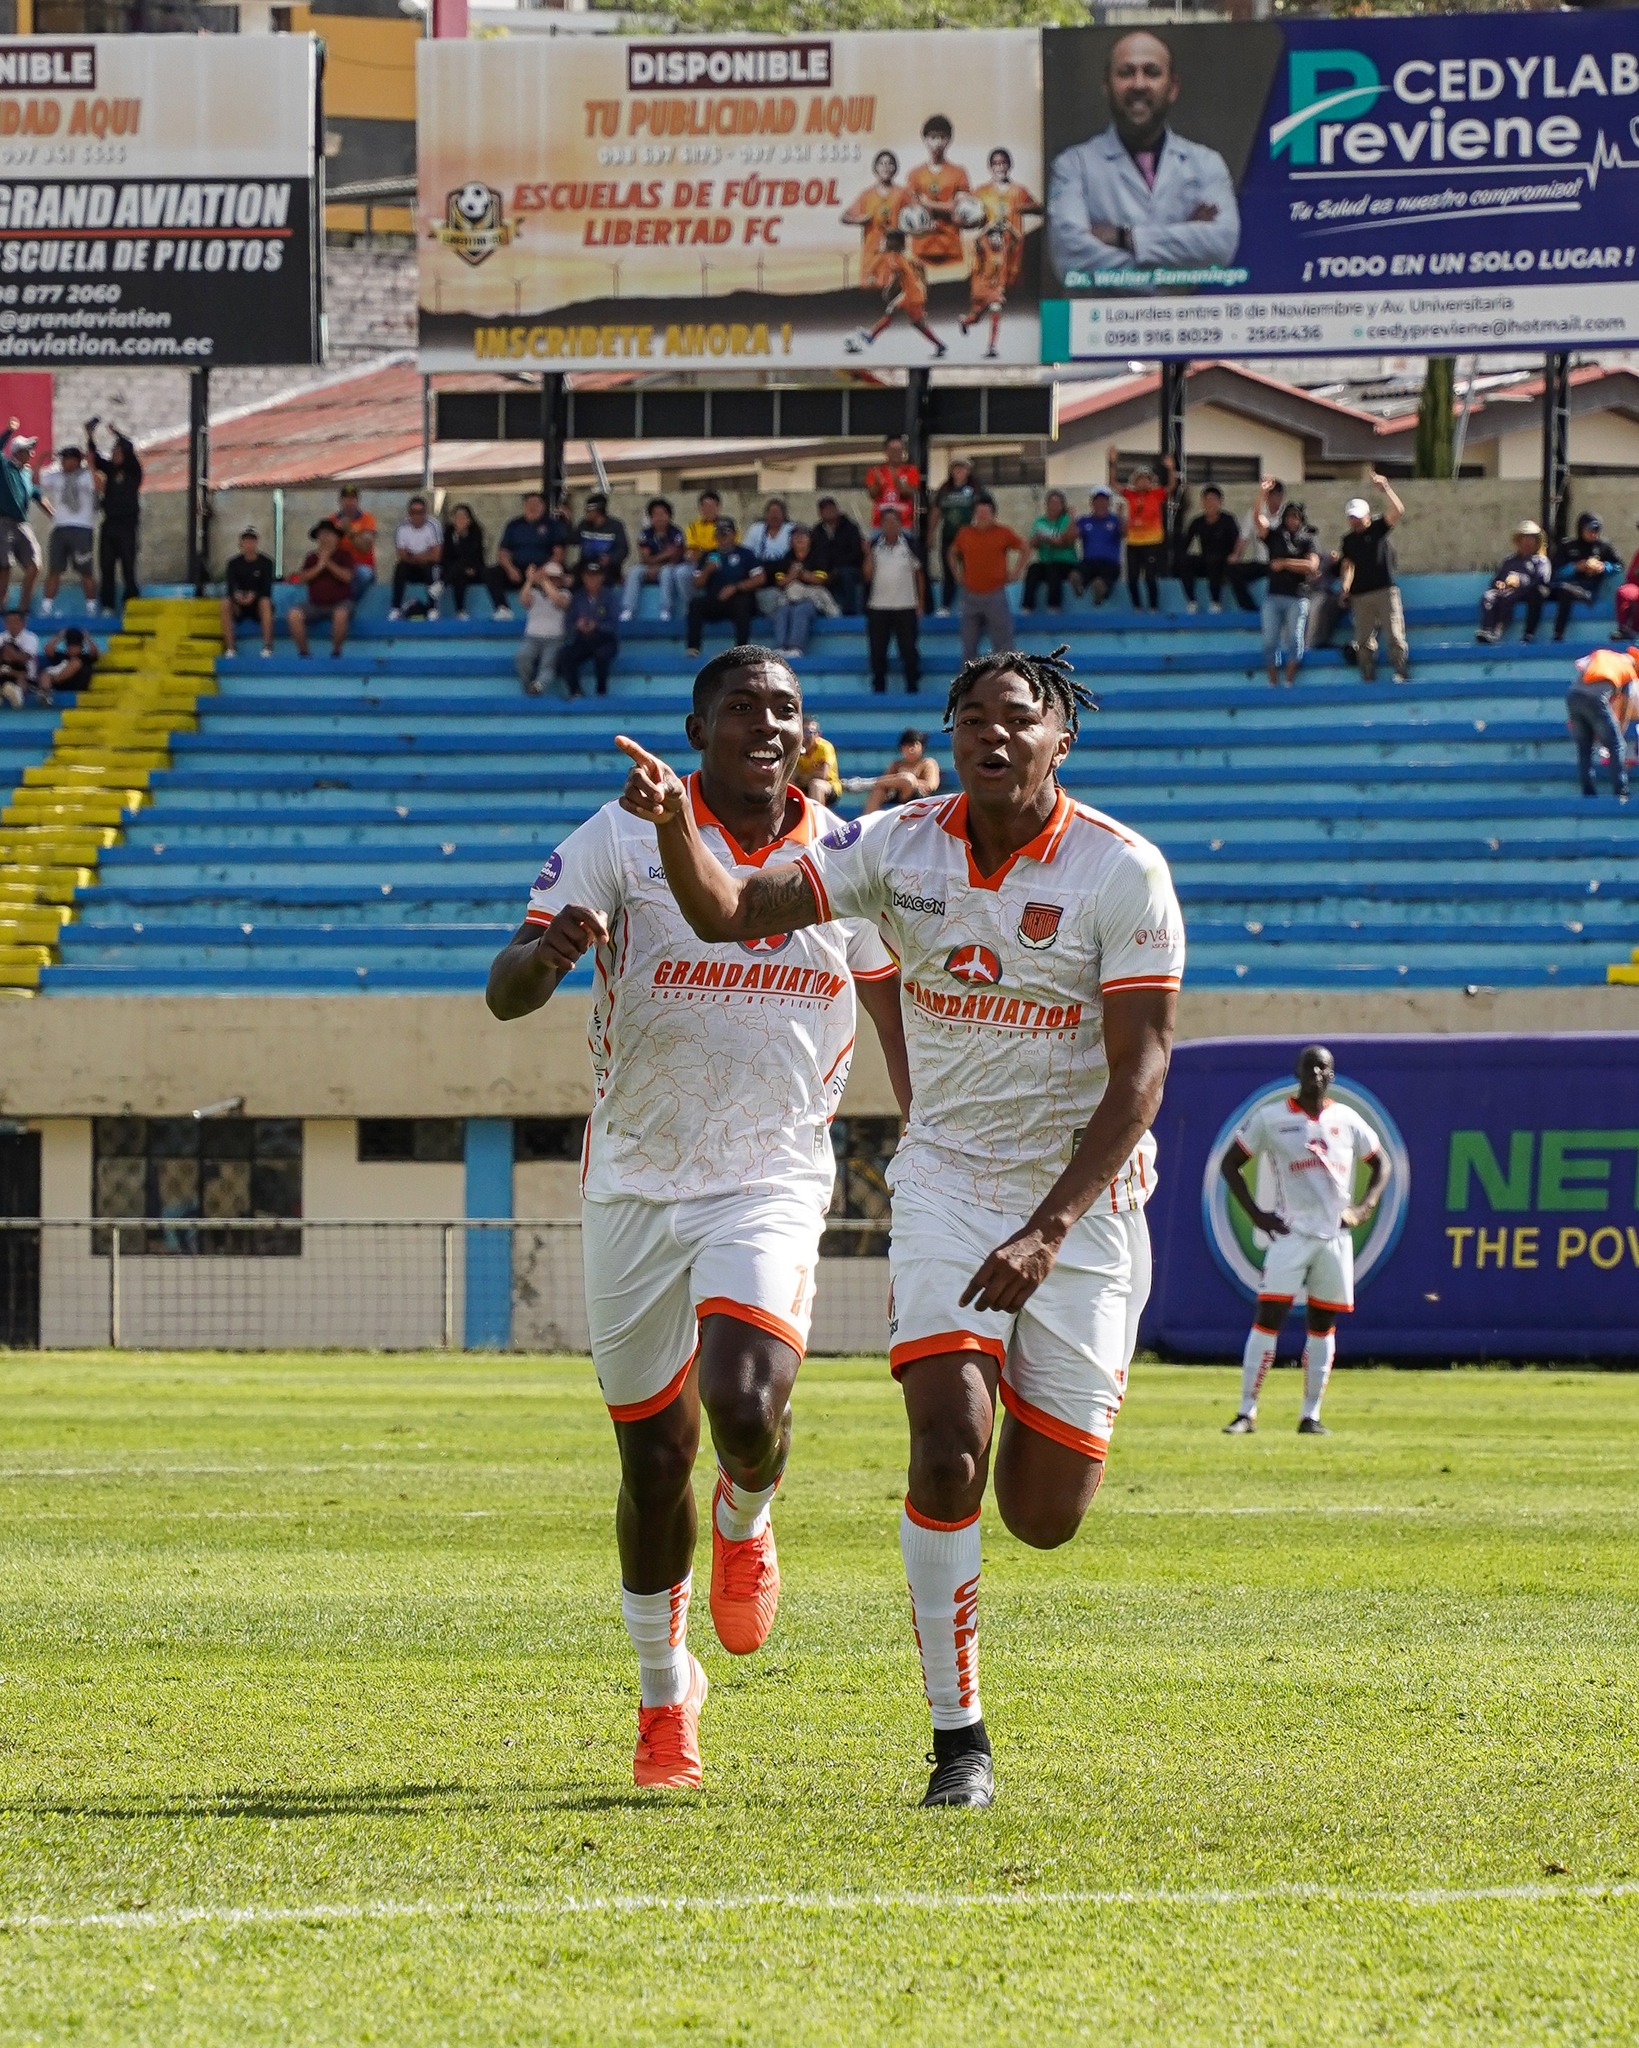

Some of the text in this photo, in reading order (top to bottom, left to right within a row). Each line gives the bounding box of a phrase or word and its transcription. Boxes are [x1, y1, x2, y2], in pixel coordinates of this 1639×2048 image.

[630, 49, 829, 84] DISPONIBLE
[1393, 52, 1639, 105] CEDYLAB
[67, 97, 142, 139] AQUI
[585, 95, 876, 138] TU PUBLICIDAD AQUI
[512, 171, 841, 211] ESCUELAS DE FÚTBOL
[1314, 195, 1370, 219] Salud
[1399, 188, 1467, 212] nuestro
[583, 216, 783, 246] LIBERTAD FC
[0, 239, 284, 273] SCUELA DE PILOTOS
[1318, 255, 1387, 279] TODO
[1391, 253, 1425, 276] EN
[1429, 251, 1466, 274] UN
[1468, 250, 1534, 273] SOLO
[1538, 246, 1621, 270] LUGAR
[21, 284, 65, 304] 877
[66, 283, 122, 304] 2060
[1105, 306, 1171, 323] Lourdes
[1176, 306, 1219, 320] entre
[1245, 302, 1265, 318] de
[1271, 297, 1362, 317] Noviembre
[1409, 294, 1515, 314] Universitaria
[473, 323, 654, 359] INSCRIBETE
[663, 322, 771, 357] AHORA
[893, 891, 946, 916] MACON
[653, 960, 847, 998] GRANDAVIATION
[996, 1030, 1077, 1041] PILOTOS
[1445, 1226, 1540, 1269] THE
